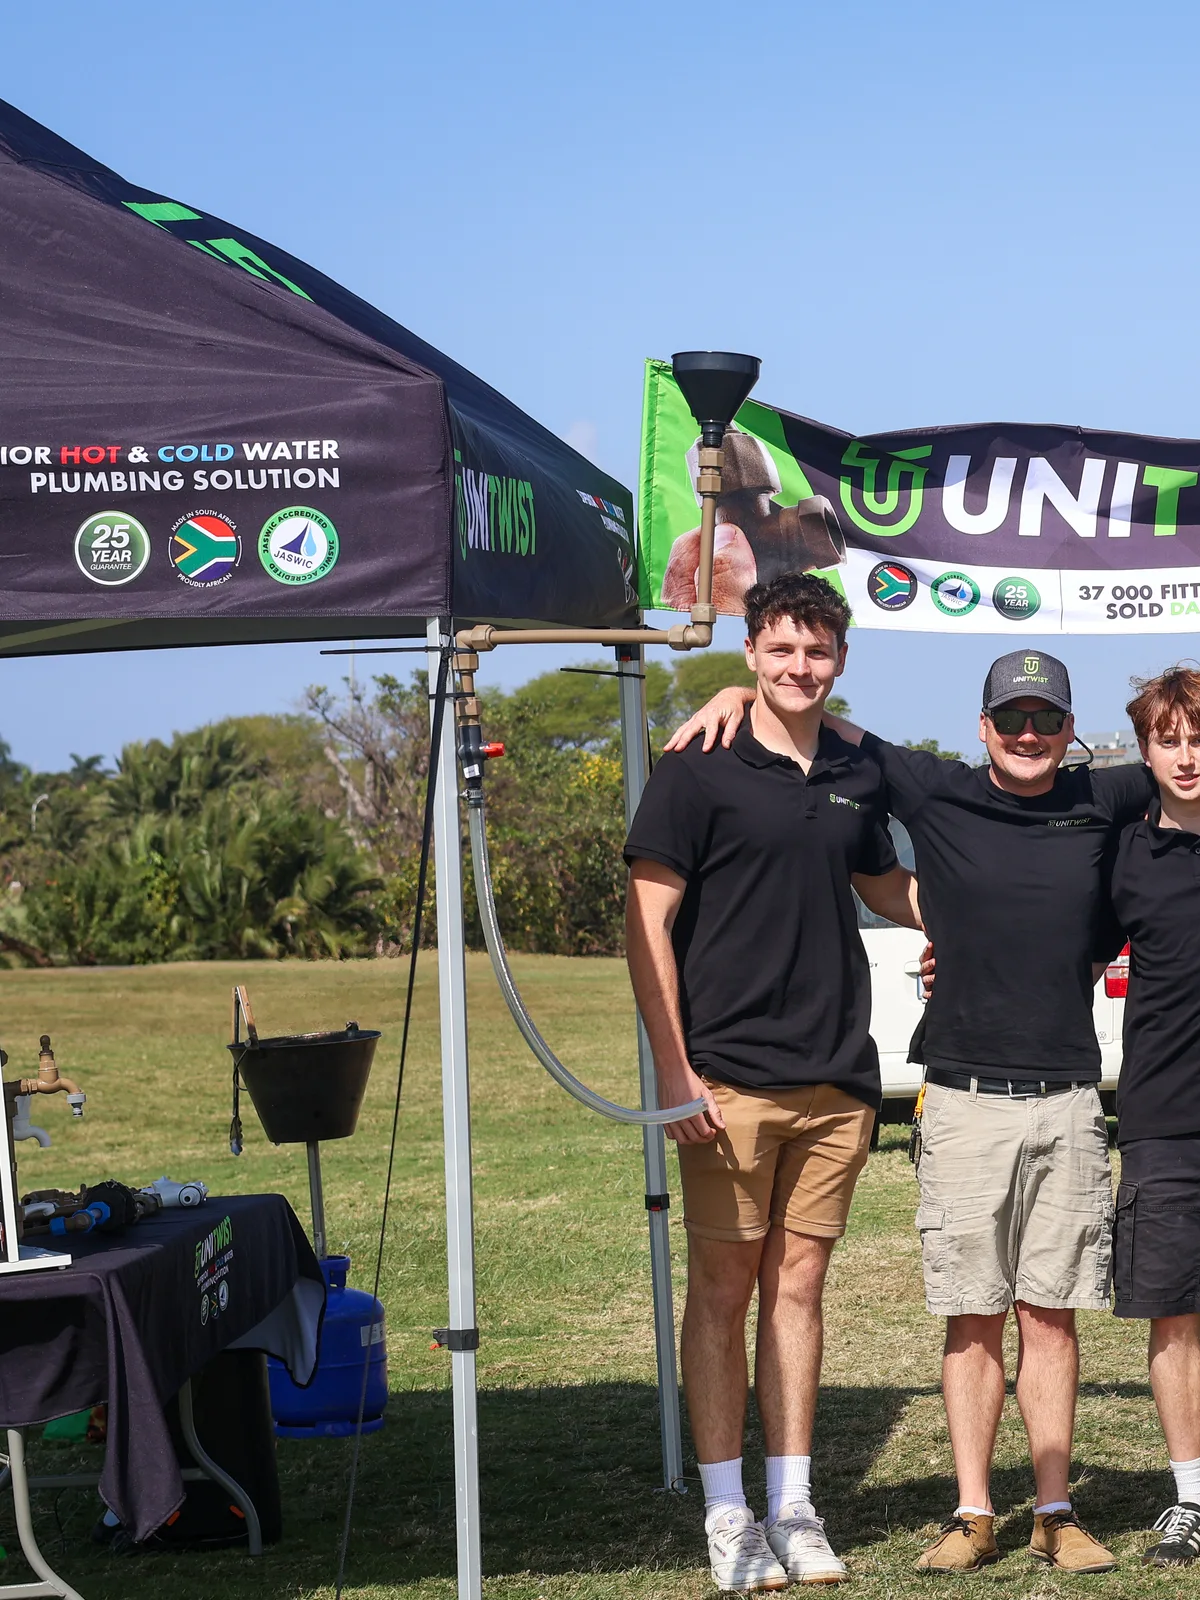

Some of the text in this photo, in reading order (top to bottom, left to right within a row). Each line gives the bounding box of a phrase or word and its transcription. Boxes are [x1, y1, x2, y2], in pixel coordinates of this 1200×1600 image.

[60, 446, 121, 464] HOT
[128, 446, 149, 464] &
[157, 444, 235, 462] COLD
[242, 440, 340, 461] WATER
[30, 467, 340, 493] PLUMBING SOLUTION
[462, 466, 536, 556] UNITWIST
[171, 509, 238, 532] MADE IN SOUTH AFRICA
[90, 524, 130, 549] 25
[262, 510, 328, 554] JASWIC ACCREDITED
[91, 550, 132, 563] YEAR
[269, 540, 335, 581] JASWIC ACCREDITED
[273, 550, 313, 569] JASWIC
[90, 563, 132, 571] GUARANTEE
[177, 572, 233, 588] PROUDLY AFRICAN
[1004, 585, 1028, 599] 25
[1078, 585, 1105, 600] 37
[1111, 585, 1153, 601] 000
[1005, 598, 1029, 608] YEAR
[1106, 602, 1163, 620] SOLD
[1013, 675, 1049, 683] UNITWIST
[1056, 818, 1091, 827] UNITWIST
